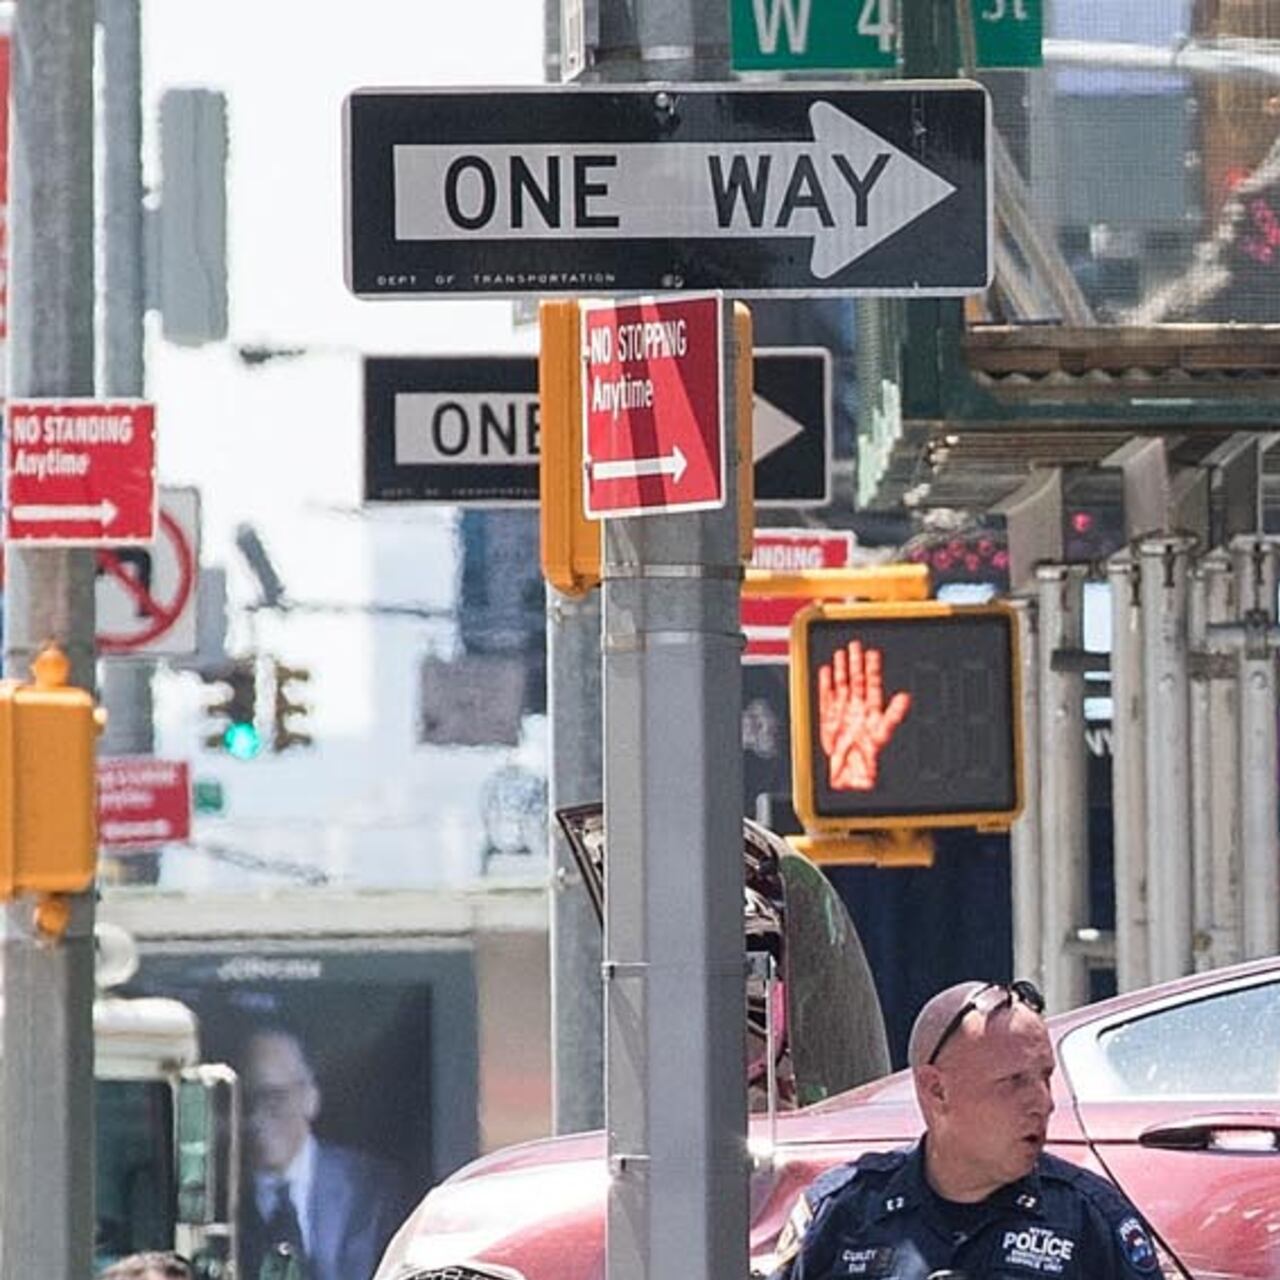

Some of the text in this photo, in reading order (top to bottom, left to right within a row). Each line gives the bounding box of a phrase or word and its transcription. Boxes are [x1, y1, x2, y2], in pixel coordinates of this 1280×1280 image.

[754, 0, 812, 53] W
[857, 0, 899, 52] 4
[444, 153, 892, 230] ONE WAY
[377, 273, 616, 286] DEPT OF TRANSPORTATION
[590, 319, 688, 364] NO STOPPING
[591, 372, 654, 421] Anytime
[13, 415, 134, 445] NO STANDING
[14, 449, 91, 482] Anytime
[1002, 1231, 1075, 1261] POLICE
